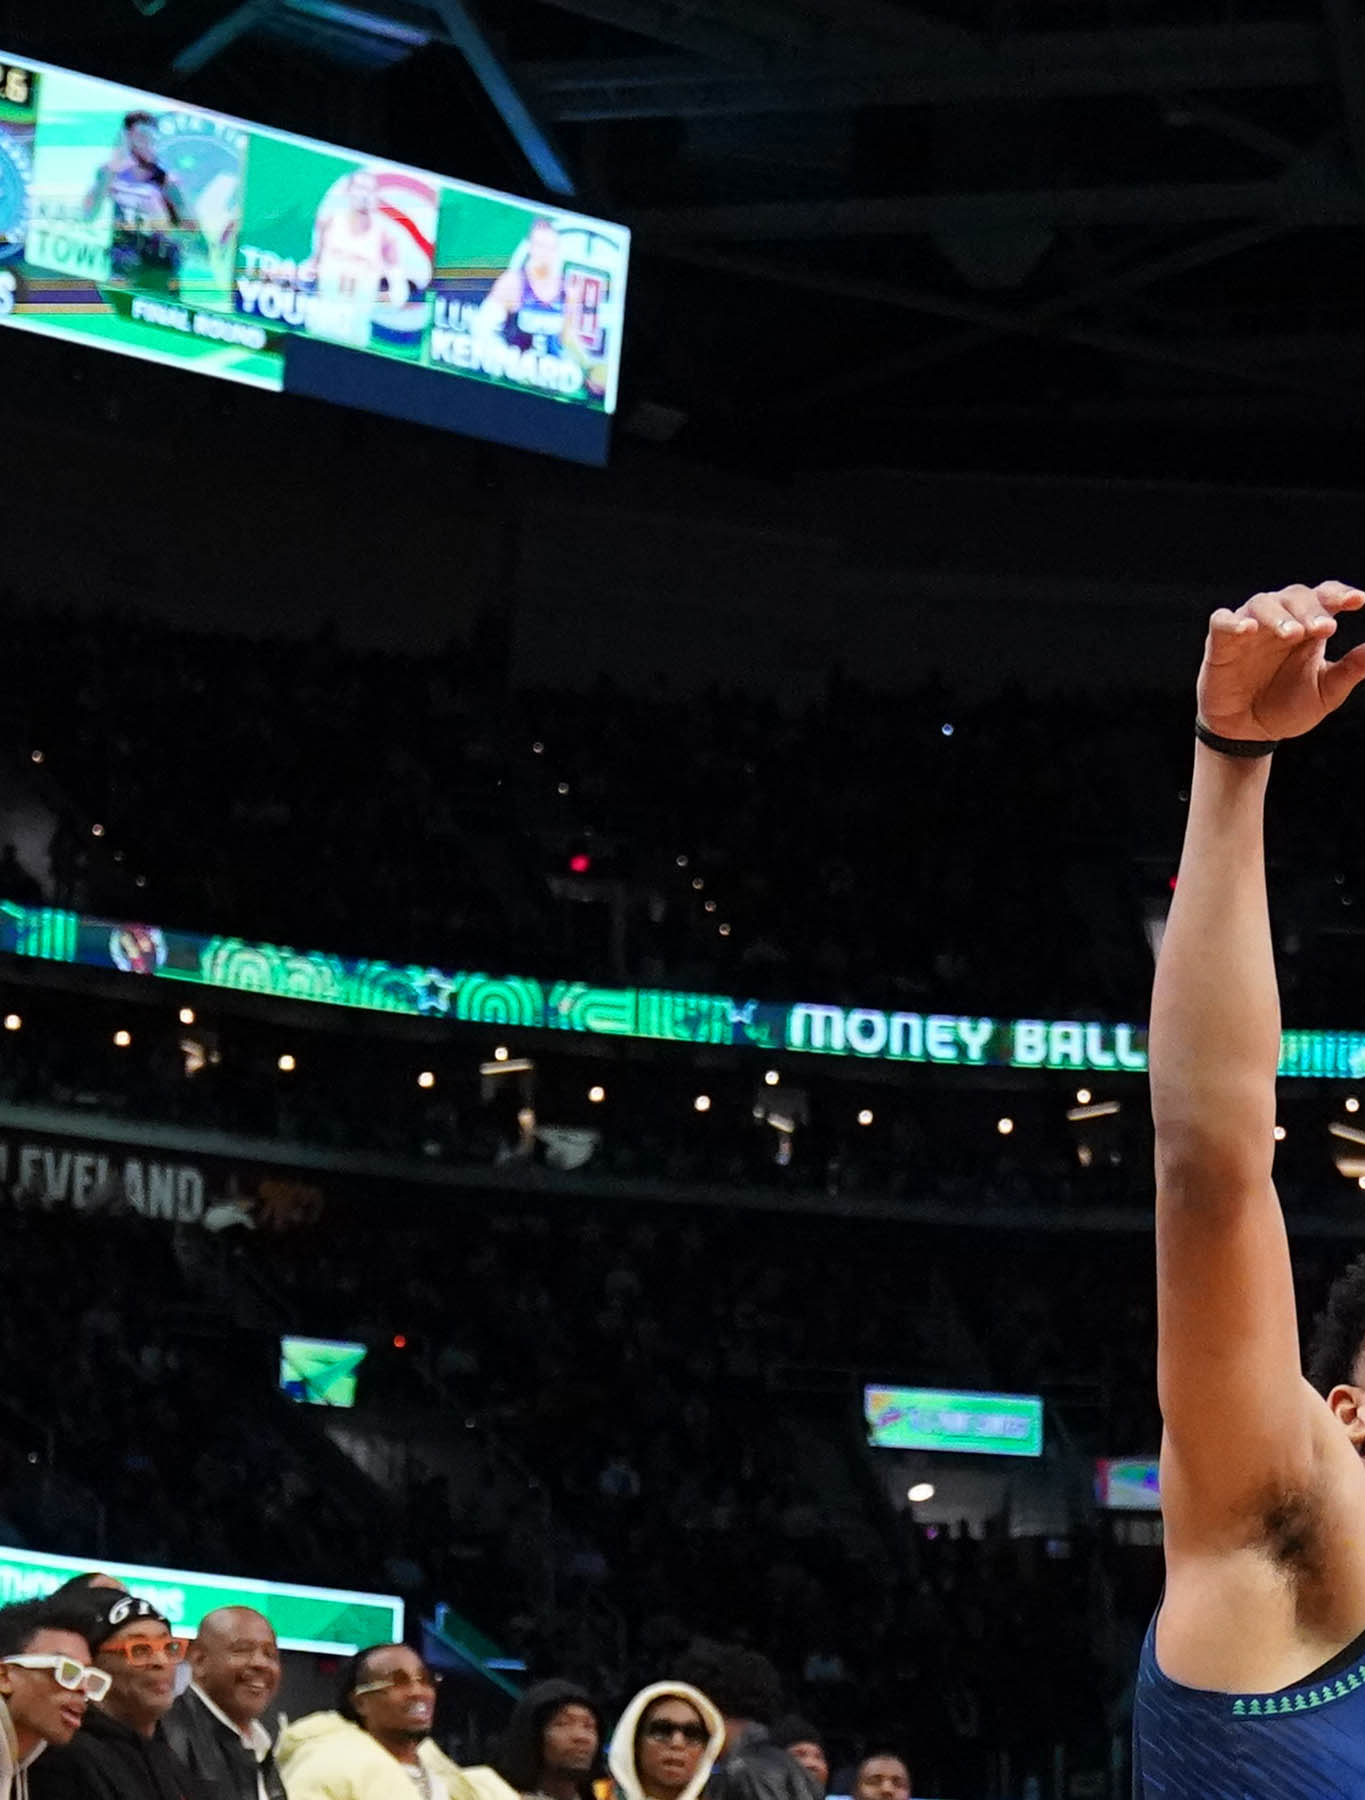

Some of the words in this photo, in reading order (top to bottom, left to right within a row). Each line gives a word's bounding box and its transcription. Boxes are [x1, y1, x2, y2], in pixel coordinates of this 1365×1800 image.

[132, 298, 192, 333] FINAL
[788, 1003, 992, 1063] MONEY
[1013, 1019, 1147, 1069] BALL
